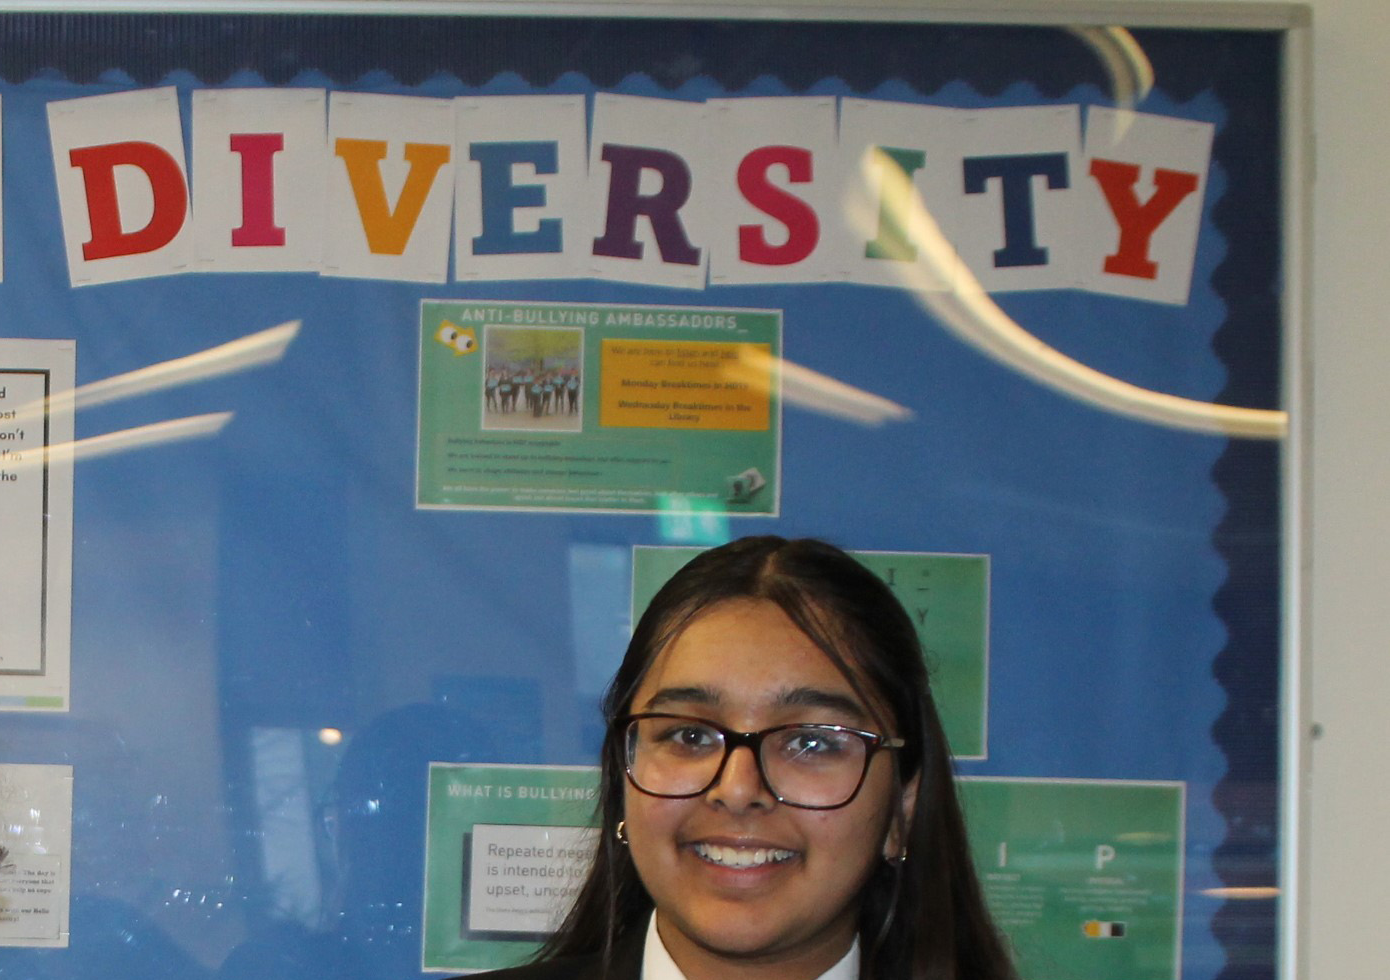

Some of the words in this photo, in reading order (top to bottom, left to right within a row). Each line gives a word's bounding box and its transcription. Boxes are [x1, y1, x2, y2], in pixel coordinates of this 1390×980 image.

[69, 132, 1199, 281] DIVERSITY
[461, 308, 599, 325] ANTI-BULLYING
[448, 785, 493, 797] WHAT
[498, 786, 512, 797] IS
[488, 844, 554, 859] Repeated
[998, 842, 1007, 867] I
[1095, 844, 1116, 870] P
[487, 866, 498, 876] is
[503, 865, 564, 877] intended
[487, 885, 529, 898] upset,
